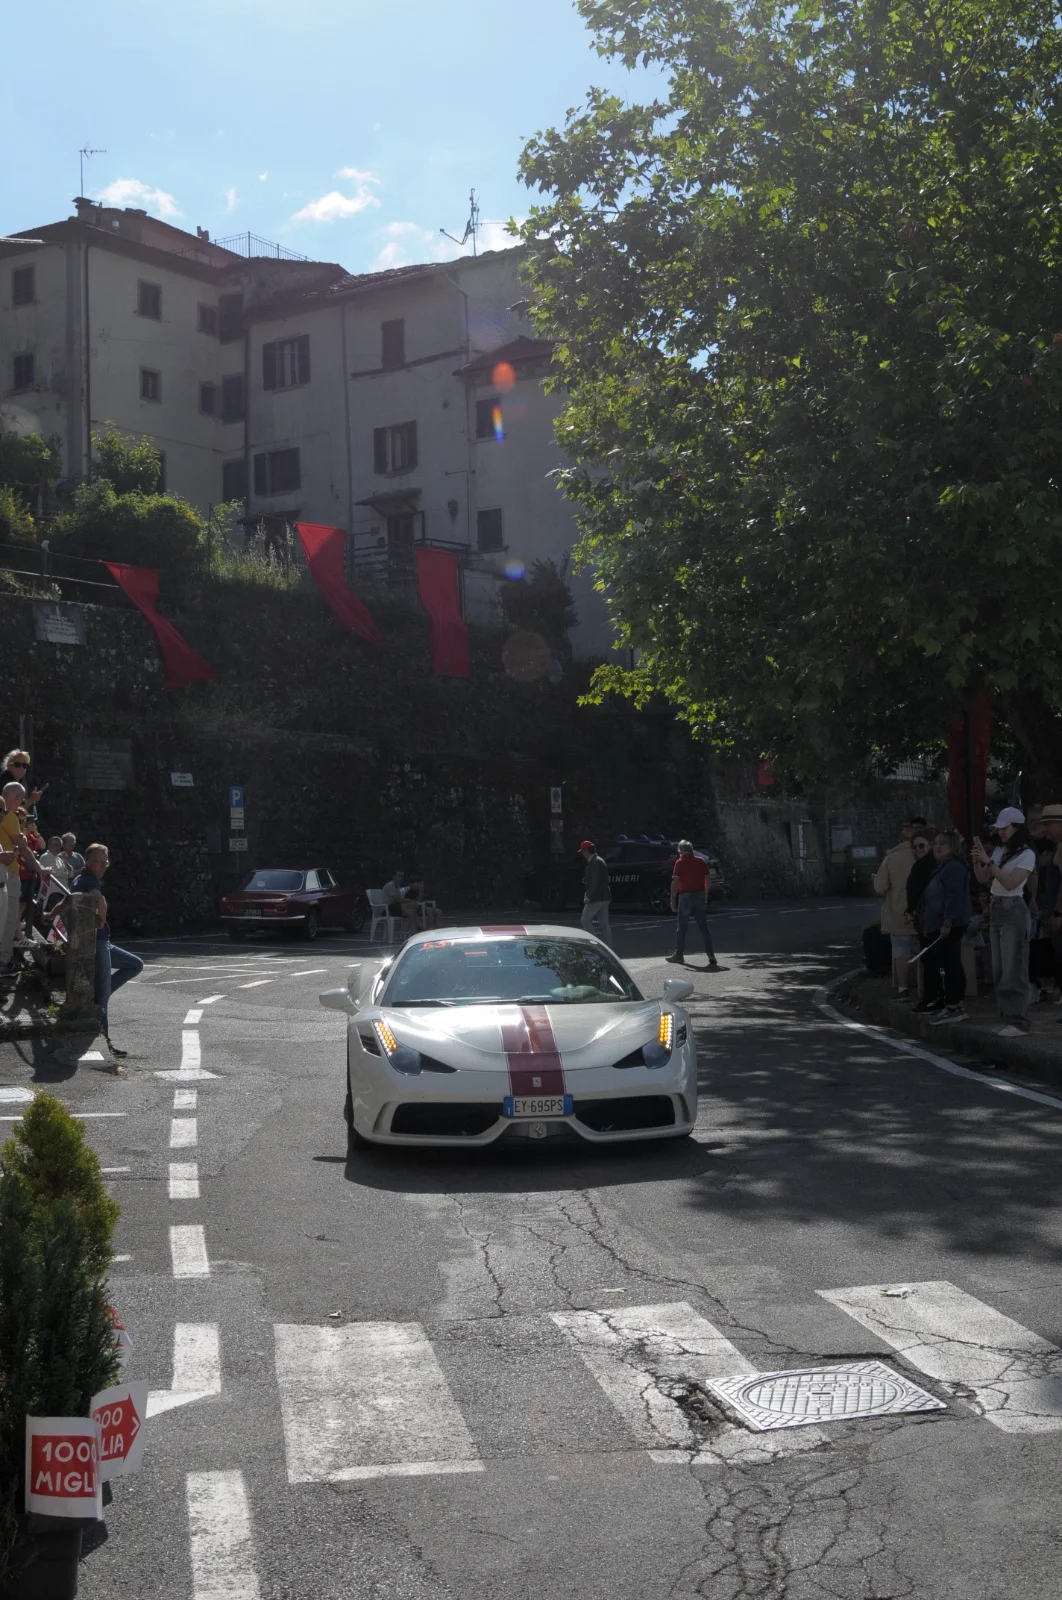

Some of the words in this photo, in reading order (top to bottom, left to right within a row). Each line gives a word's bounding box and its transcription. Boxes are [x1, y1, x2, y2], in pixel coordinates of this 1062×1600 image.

[232, 789, 240, 807] P
[95, 1406, 123, 1429] 000
[100, 1433, 124, 1456] LIA
[35, 1471, 97, 1492] MIGLI
